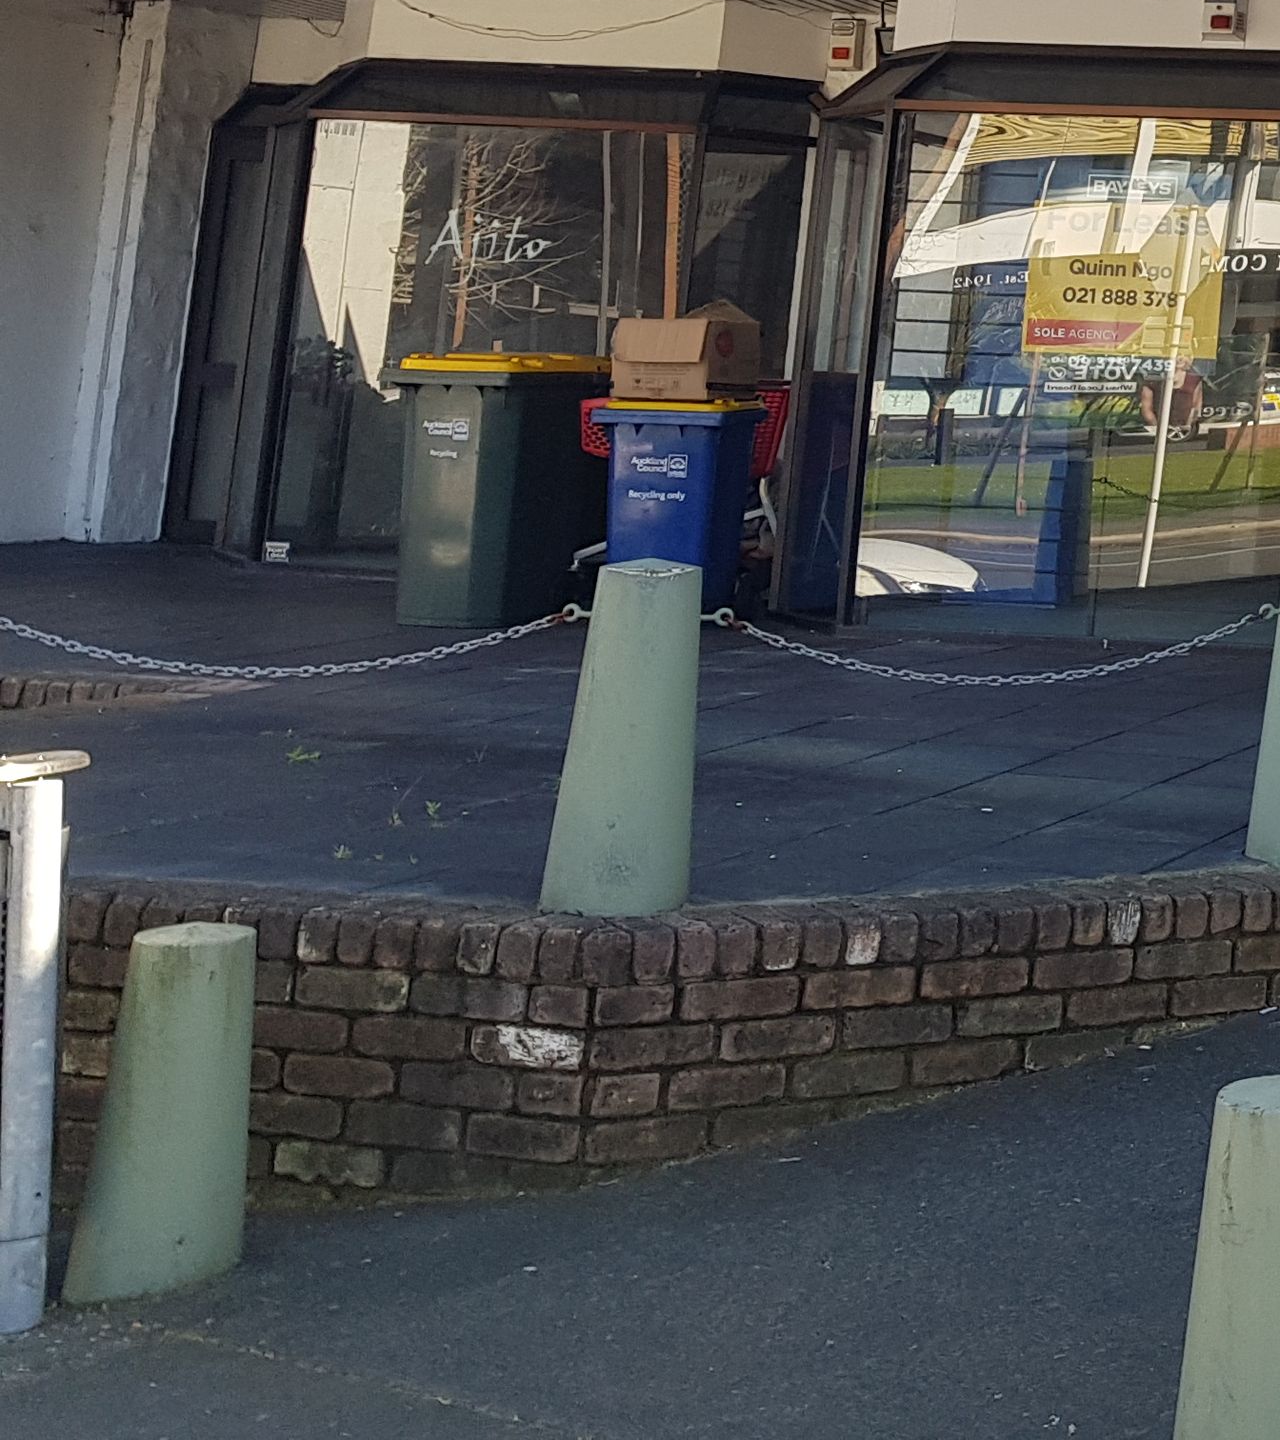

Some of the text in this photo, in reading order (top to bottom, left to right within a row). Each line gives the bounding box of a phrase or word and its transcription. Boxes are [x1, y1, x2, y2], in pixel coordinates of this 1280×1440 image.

[1093, 179, 1172, 195] BAYLEYS
[1048, 207, 1210, 238] For Lease
[425, 209, 549, 283] Ajito
[1069, 259, 1172, 282] Quinn Ngo
[1062, 287, 1179, 308] 021 888 378
[1033, 327, 1119, 341] SOLE AGENCY
[429, 448, 458, 459] Recycling
[631, 456, 668, 466] Auckland
[637, 464, 668, 473] Council
[628, 490, 686, 501] Recycling only
